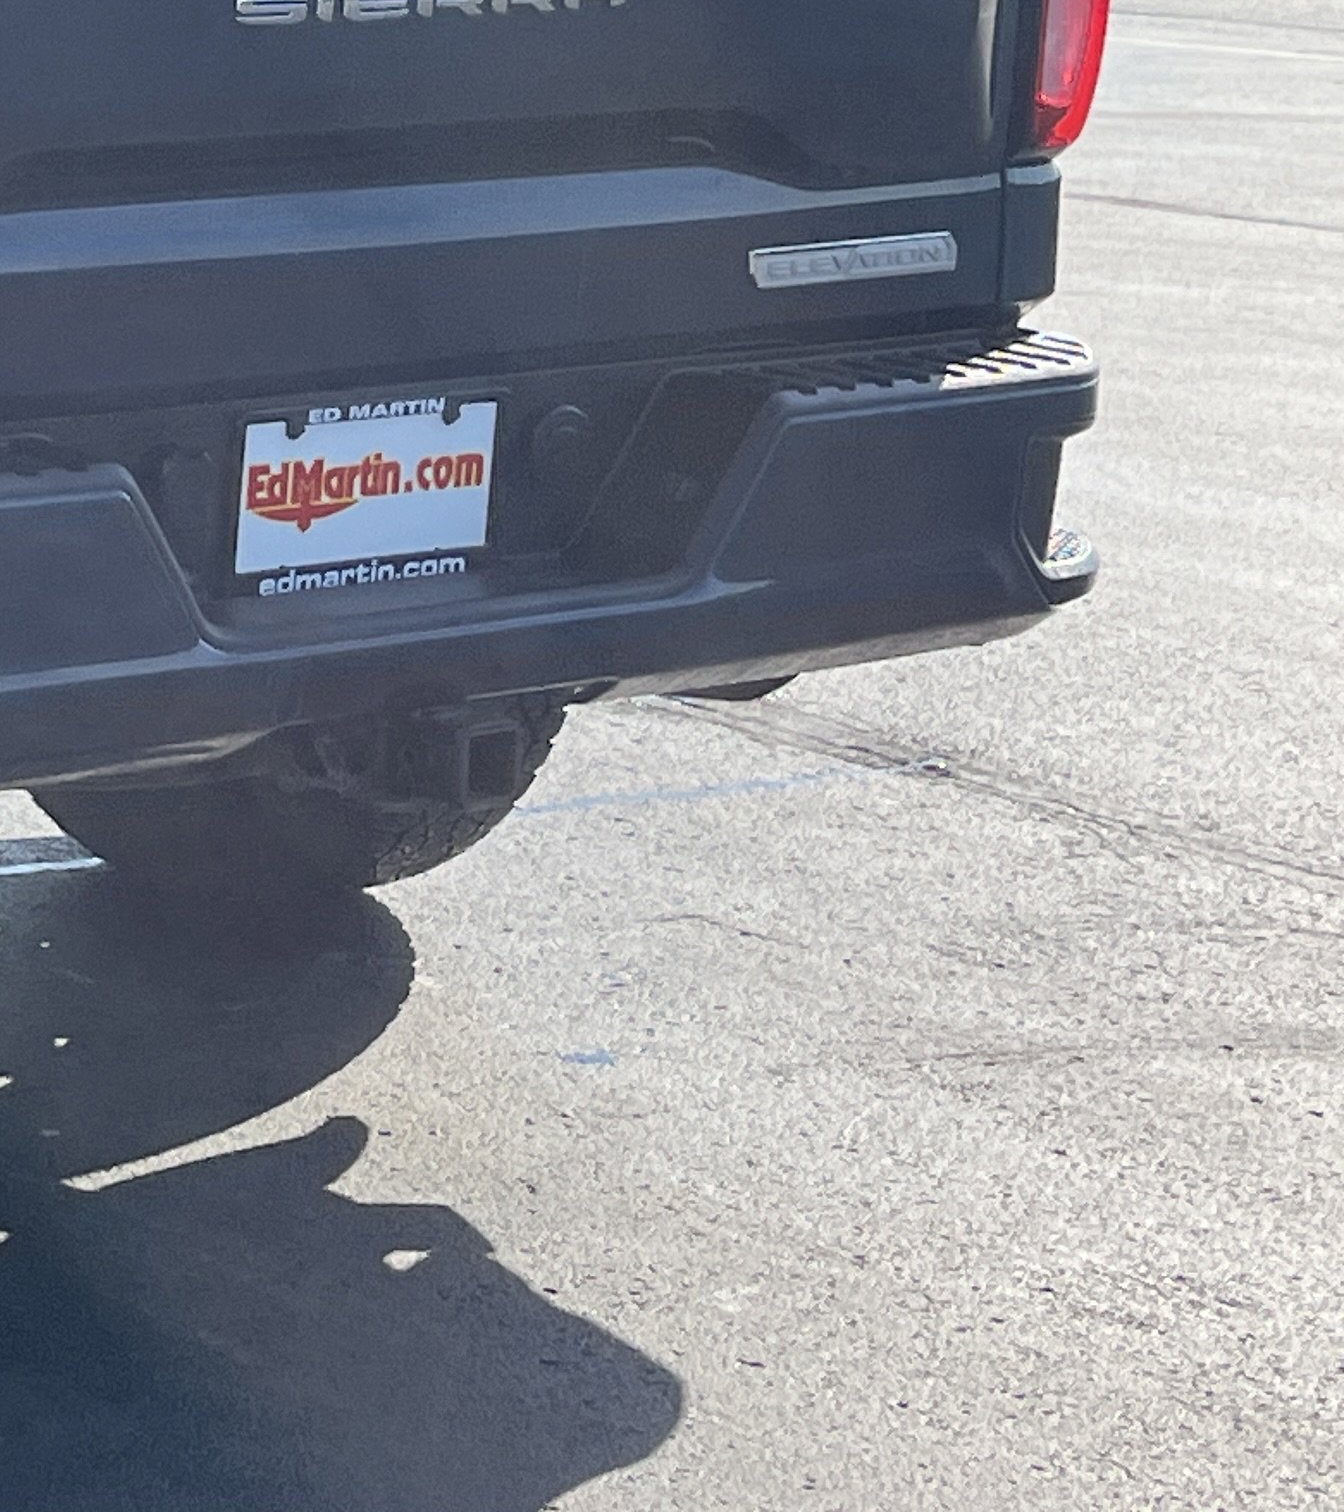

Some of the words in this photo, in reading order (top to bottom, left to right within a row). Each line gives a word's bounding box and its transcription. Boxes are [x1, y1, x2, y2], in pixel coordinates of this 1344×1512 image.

[766, 246, 941, 280] ELEVATION
[308, 407, 342, 424] ED
[348, 397, 446, 421] MARTIN
[246, 452, 484, 509] EdMartin.com
[258, 555, 466, 597] edmartin.com
